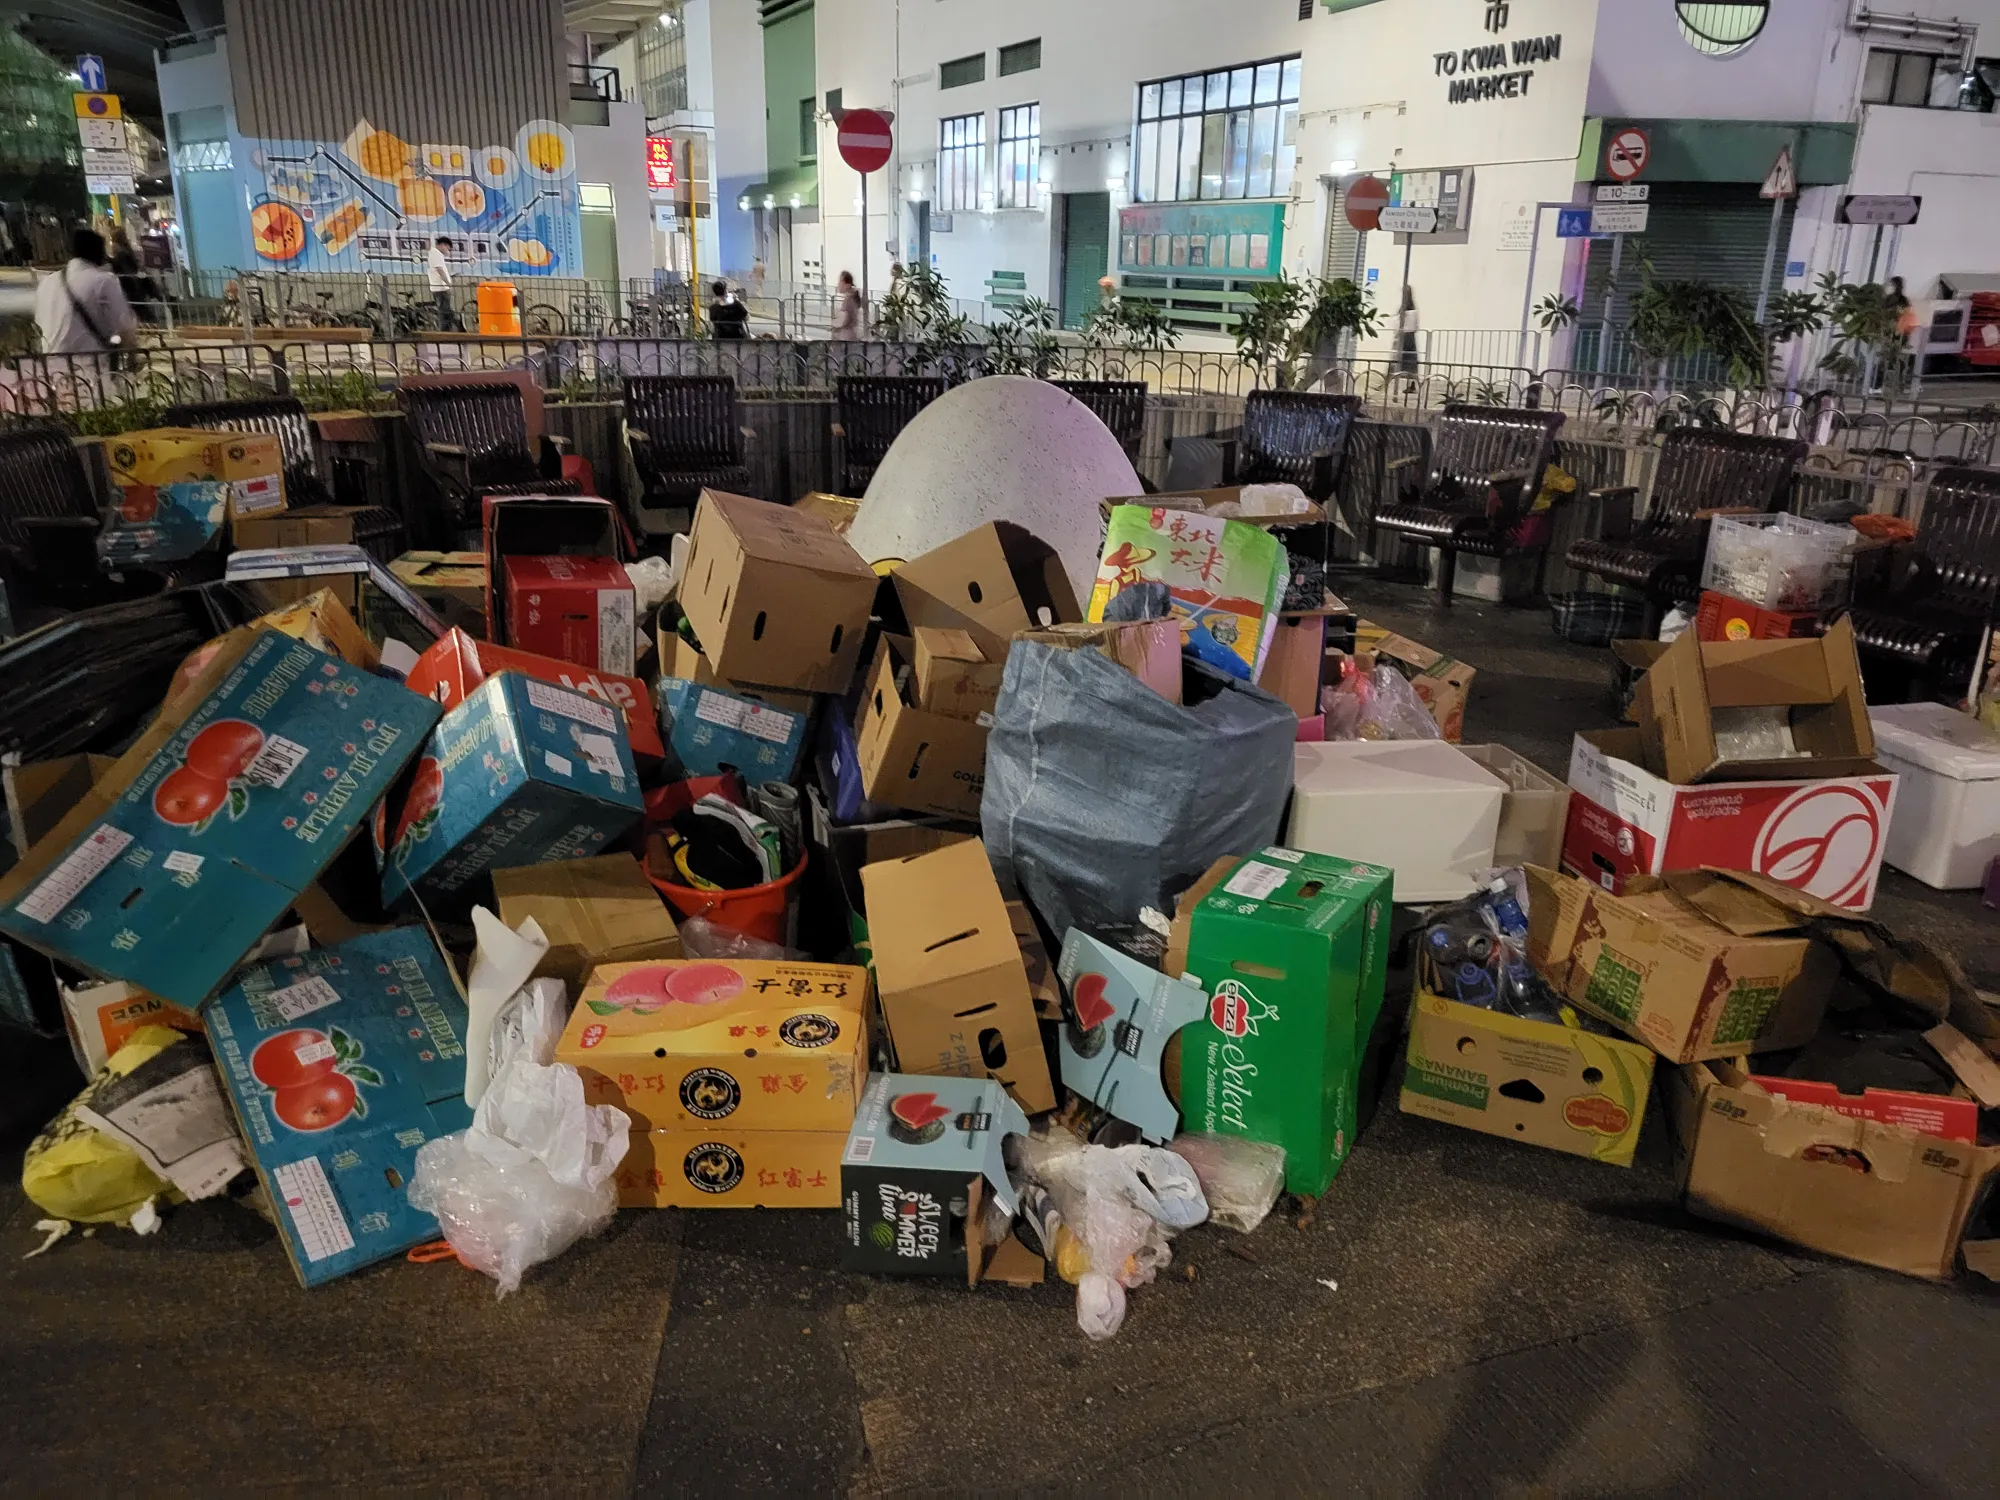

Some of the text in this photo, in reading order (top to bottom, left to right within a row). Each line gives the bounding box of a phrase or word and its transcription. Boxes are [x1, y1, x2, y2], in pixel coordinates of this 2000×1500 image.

[1433, 34, 1561, 77] TO KWA WAN
[1448, 70, 1534, 105] MARKET
[1385, 209, 1406, 217] Kowloon
[1406, 210, 1417, 218] City
[241, 671, 290, 722] APPLE
[366, 722, 402, 757] FU
[294, 771, 360, 846] APPLE
[392, 955, 425, 985] FU
[414, 1003, 464, 1059] APPLE
[1225, 982, 1237, 1032] enza
[1207, 1041, 1219, 1066] New
[1413, 1055, 1489, 1086] BANANAS
[1206, 1066, 1218, 1109] Zealand
[1221, 1040, 1259, 1131] Select
[1422, 1074, 1486, 1099] Premium
[879, 1184, 903, 1222] time
